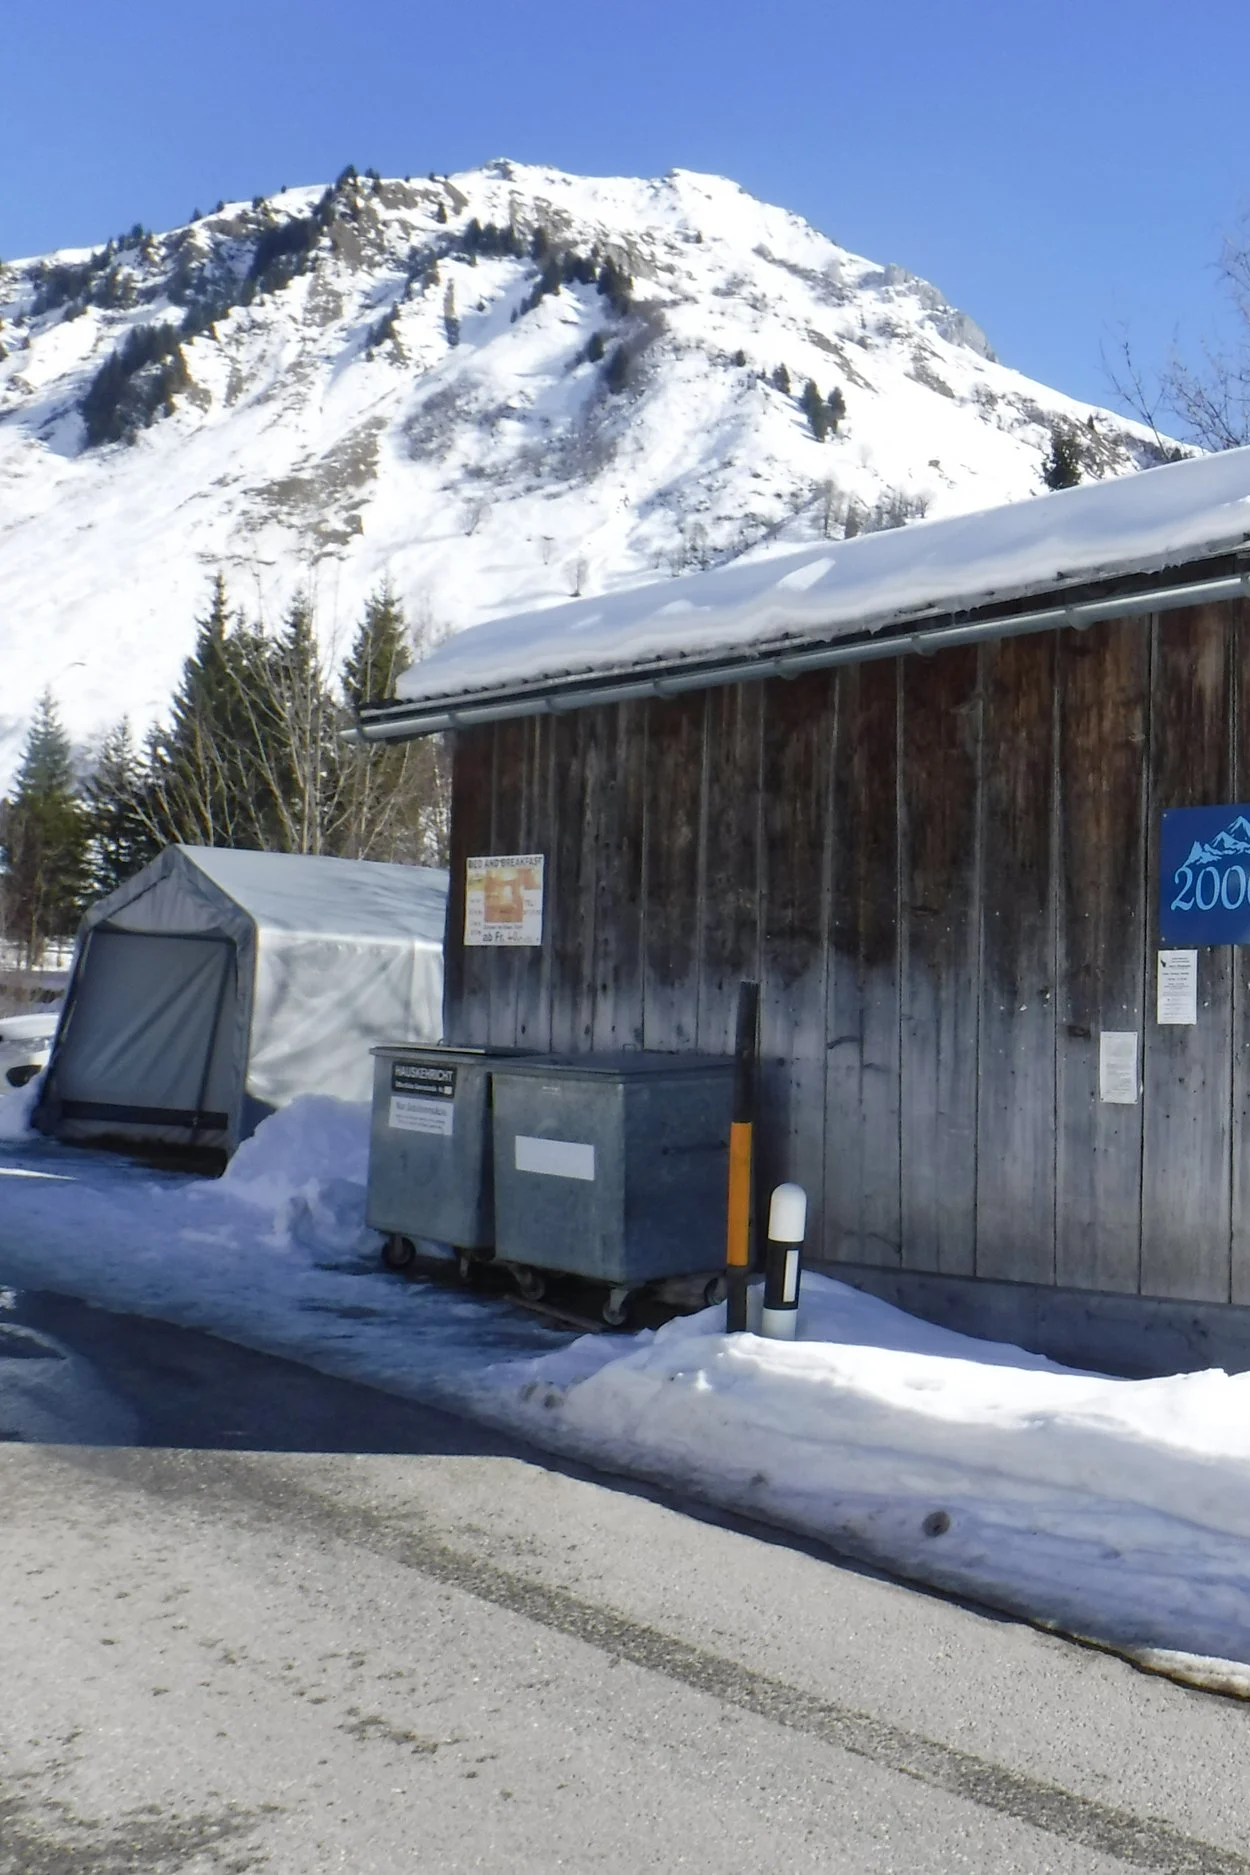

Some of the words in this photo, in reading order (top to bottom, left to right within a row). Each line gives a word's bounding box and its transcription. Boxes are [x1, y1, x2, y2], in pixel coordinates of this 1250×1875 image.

[468, 859, 483, 869] BED
[484, 858, 501, 868] AND
[501, 856, 543, 867] BREAKFAST
[395, 1065, 454, 1082] HAUSKEHRICHT
